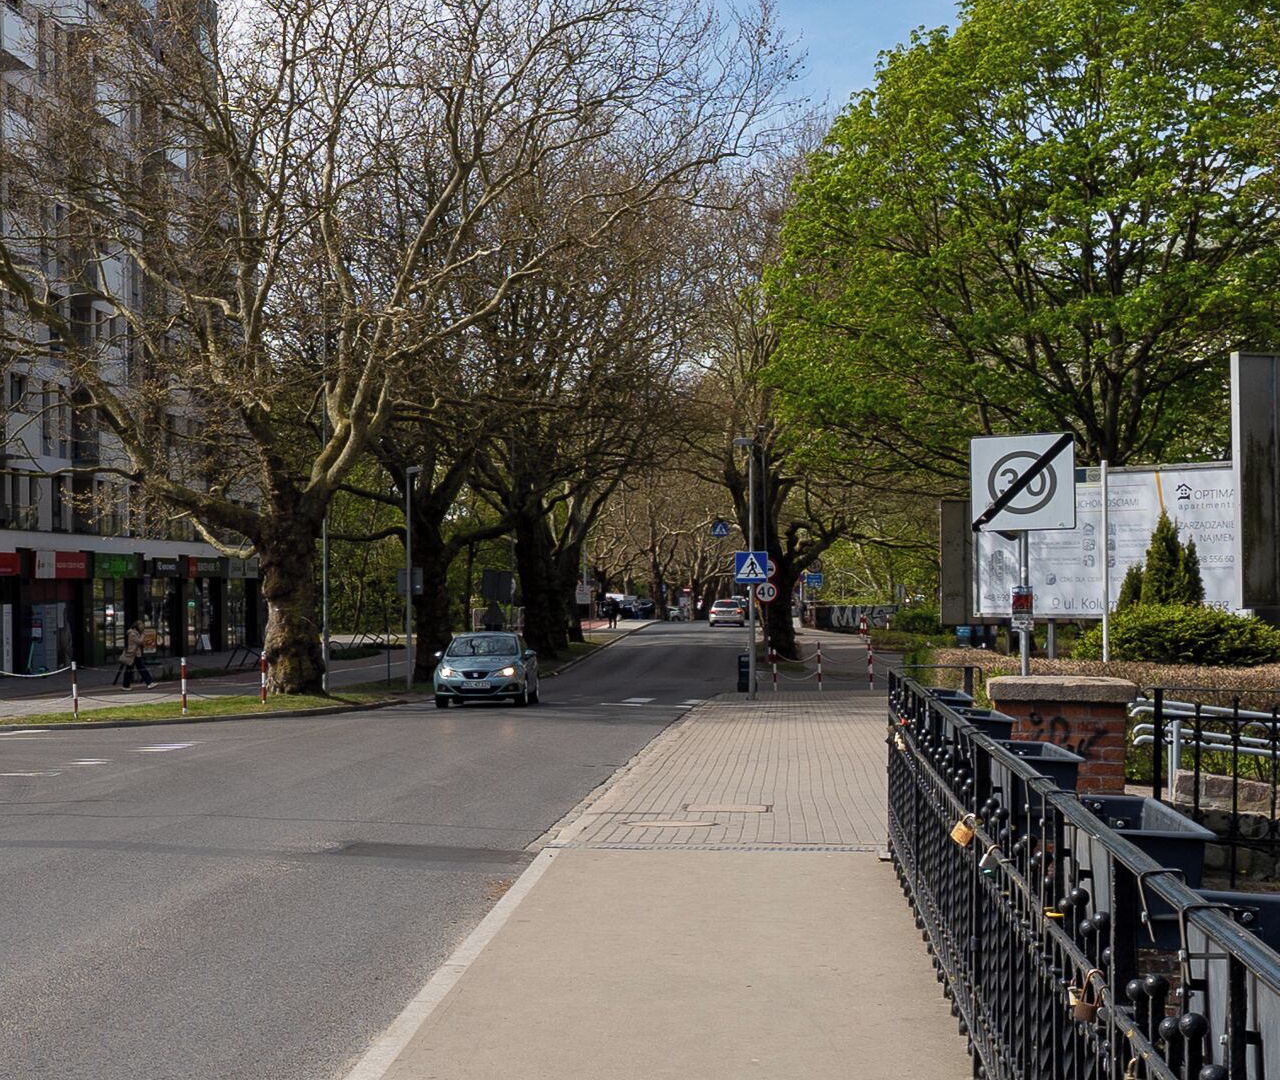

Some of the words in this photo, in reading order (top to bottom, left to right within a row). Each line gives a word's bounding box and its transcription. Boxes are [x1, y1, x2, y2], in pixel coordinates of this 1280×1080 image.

[999, 467, 1047, 497] 30
[1193, 489, 1234, 501] OPTIMA
[1178, 502, 1234, 511] apartment
[758, 586, 775, 598] 40
